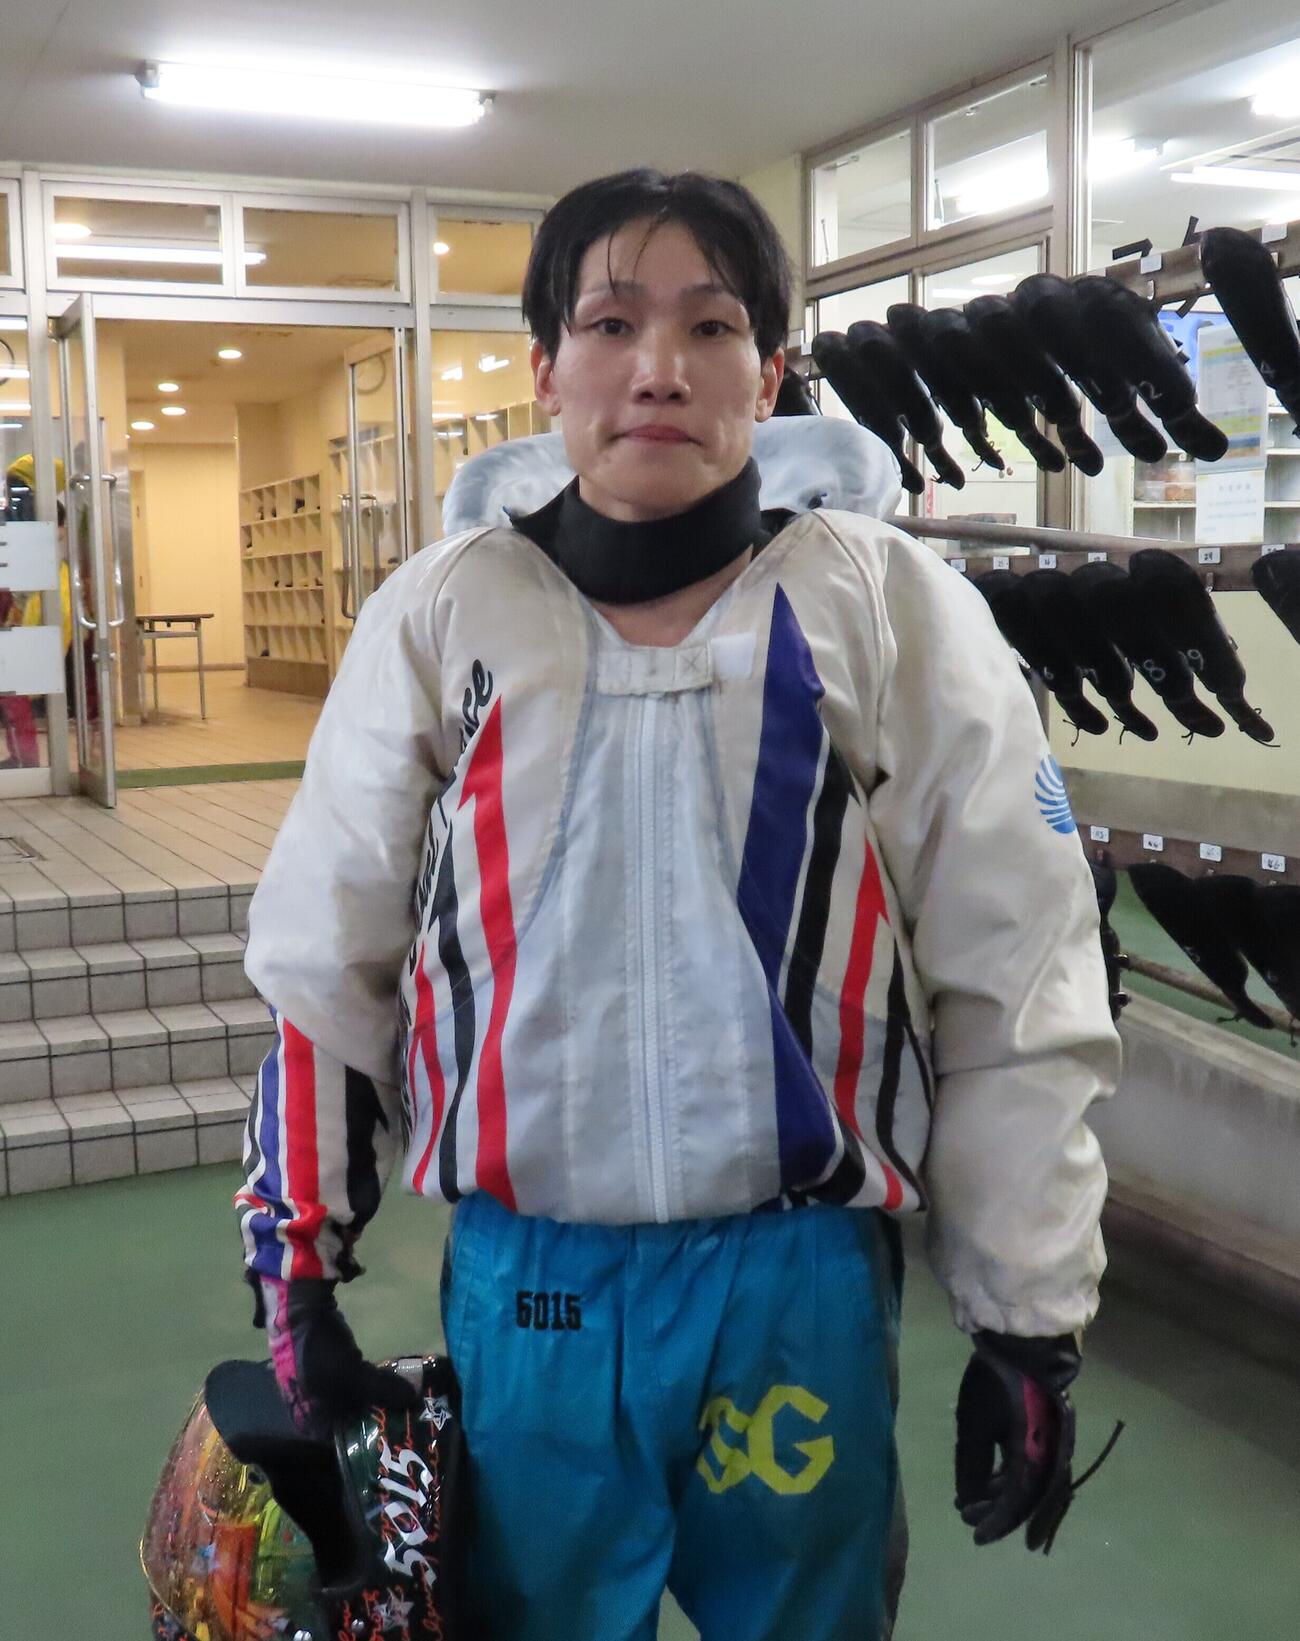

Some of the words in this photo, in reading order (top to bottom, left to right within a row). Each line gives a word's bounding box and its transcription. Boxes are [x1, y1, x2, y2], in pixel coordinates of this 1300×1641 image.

[1143, 659, 1167, 682] 8
[1186, 648, 1204, 671] 9
[379, 1436, 437, 1588] 5015
